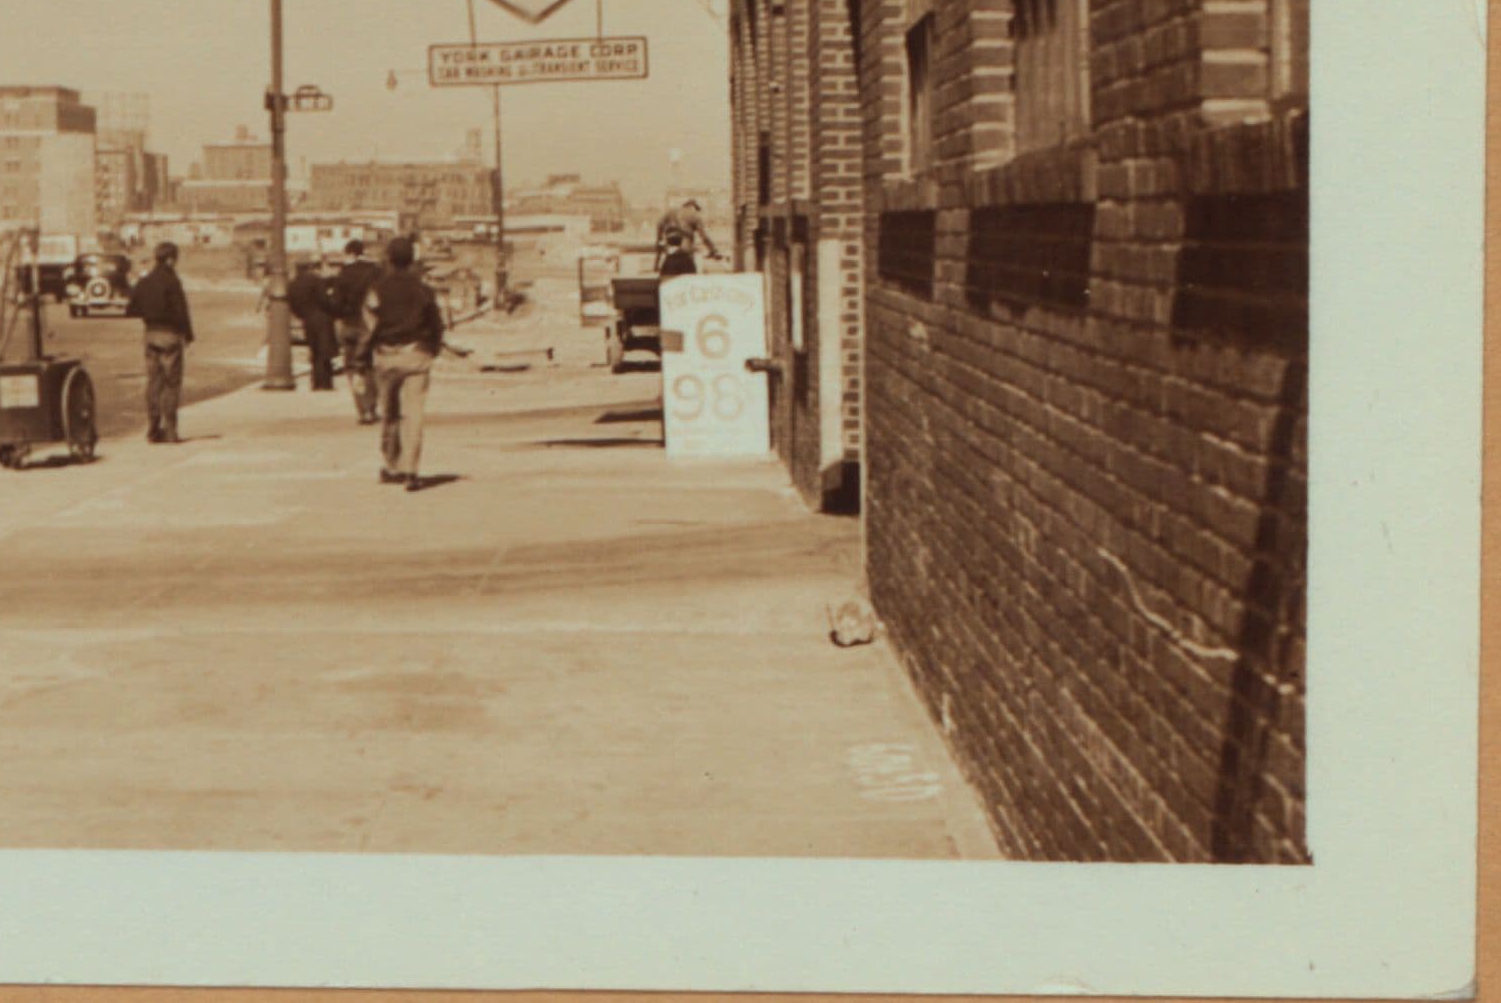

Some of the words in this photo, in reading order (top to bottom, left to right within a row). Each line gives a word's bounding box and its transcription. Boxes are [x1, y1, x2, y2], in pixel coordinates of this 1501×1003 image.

[440, 49, 489, 64] YORK
[500, 44, 580, 62] GARAGE
[589, 43, 638, 59] CORP
[695, 312, 732, 360] 6
[671, 372, 746, 422] 98
